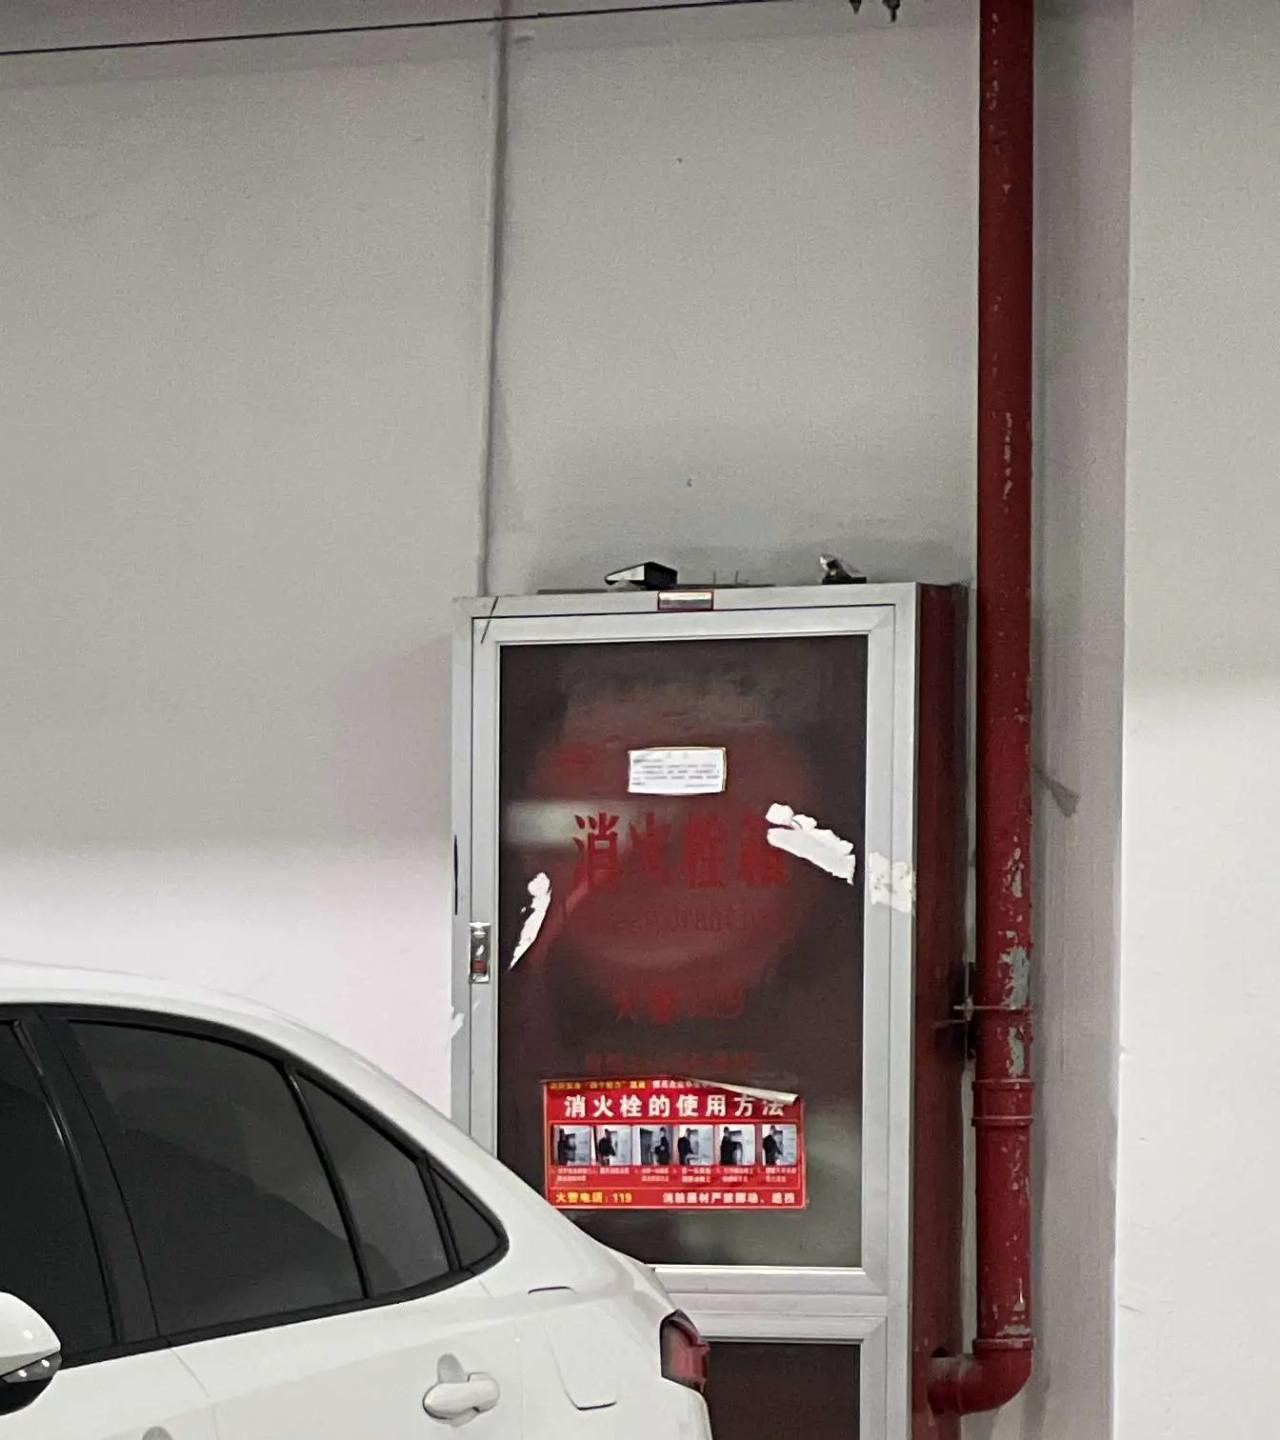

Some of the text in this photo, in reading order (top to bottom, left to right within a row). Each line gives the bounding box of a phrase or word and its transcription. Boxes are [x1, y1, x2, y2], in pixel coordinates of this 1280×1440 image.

[564, 1094, 785, 1117] 消火栓的使用方法
